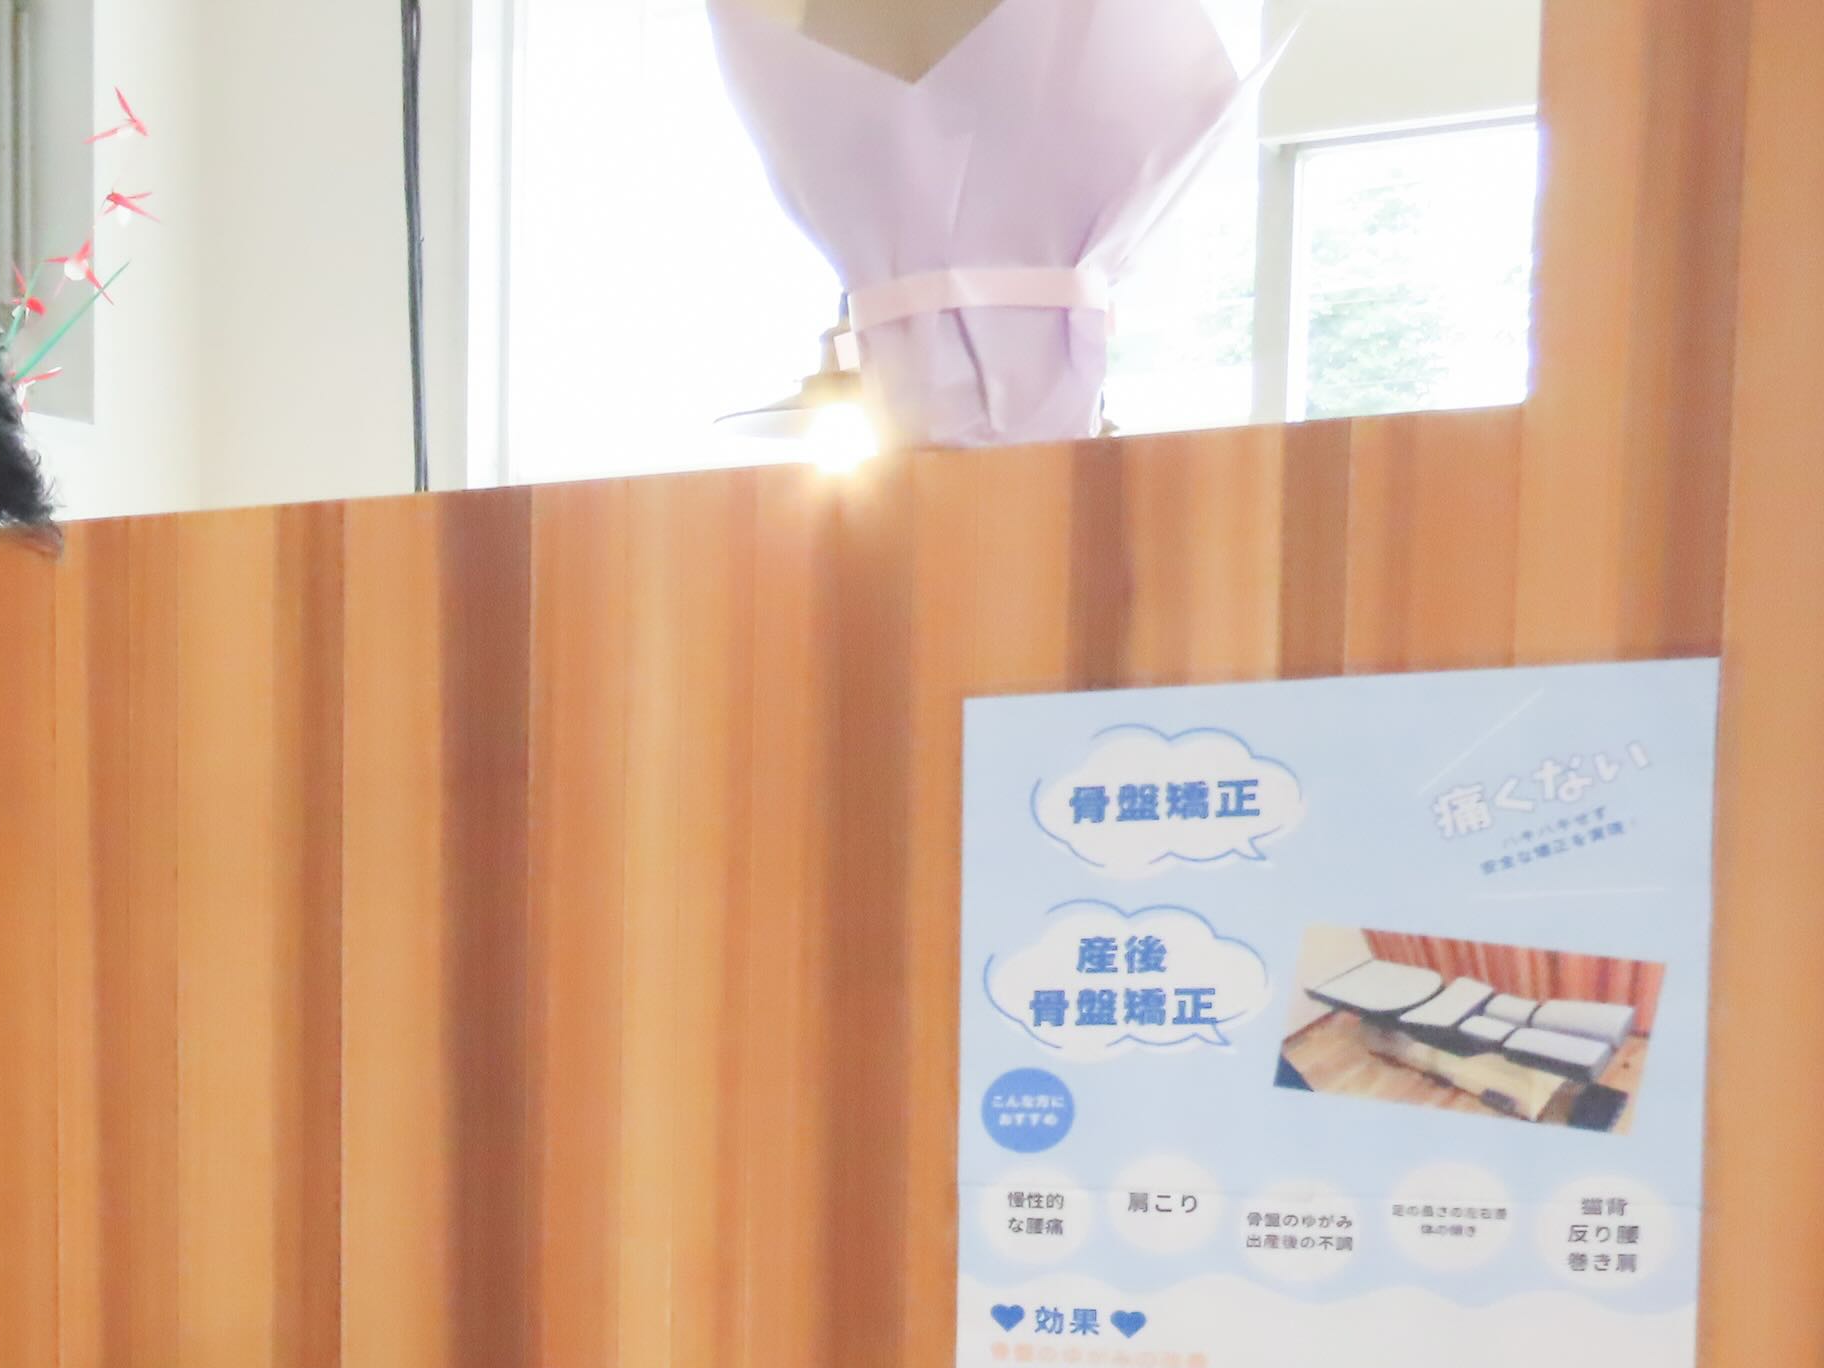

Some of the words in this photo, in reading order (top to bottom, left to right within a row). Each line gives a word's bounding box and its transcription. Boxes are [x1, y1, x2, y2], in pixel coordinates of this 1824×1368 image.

[1431, 740, 1651, 839] 痛くない
[1069, 778, 1261, 824] 骨盤矯正
[1076, 935, 1167, 974] 産後
[1028, 987, 1218, 1027] 骨盤矯正
[1007, 1191, 1065, 1210] 慢性的
[1127, 1191, 1199, 1214] 肩こり
[1007, 1217, 1065, 1236] な腰痛
[1246, 1211, 1354, 1230] 骨盤のゆがみ
[1246, 1234, 1354, 1252] 出産後の不調
[1567, 1224, 1641, 1245] 反り腰
[1567, 1252, 1638, 1274] 巻き肩
[1034, 1305, 1101, 1337] 効果
